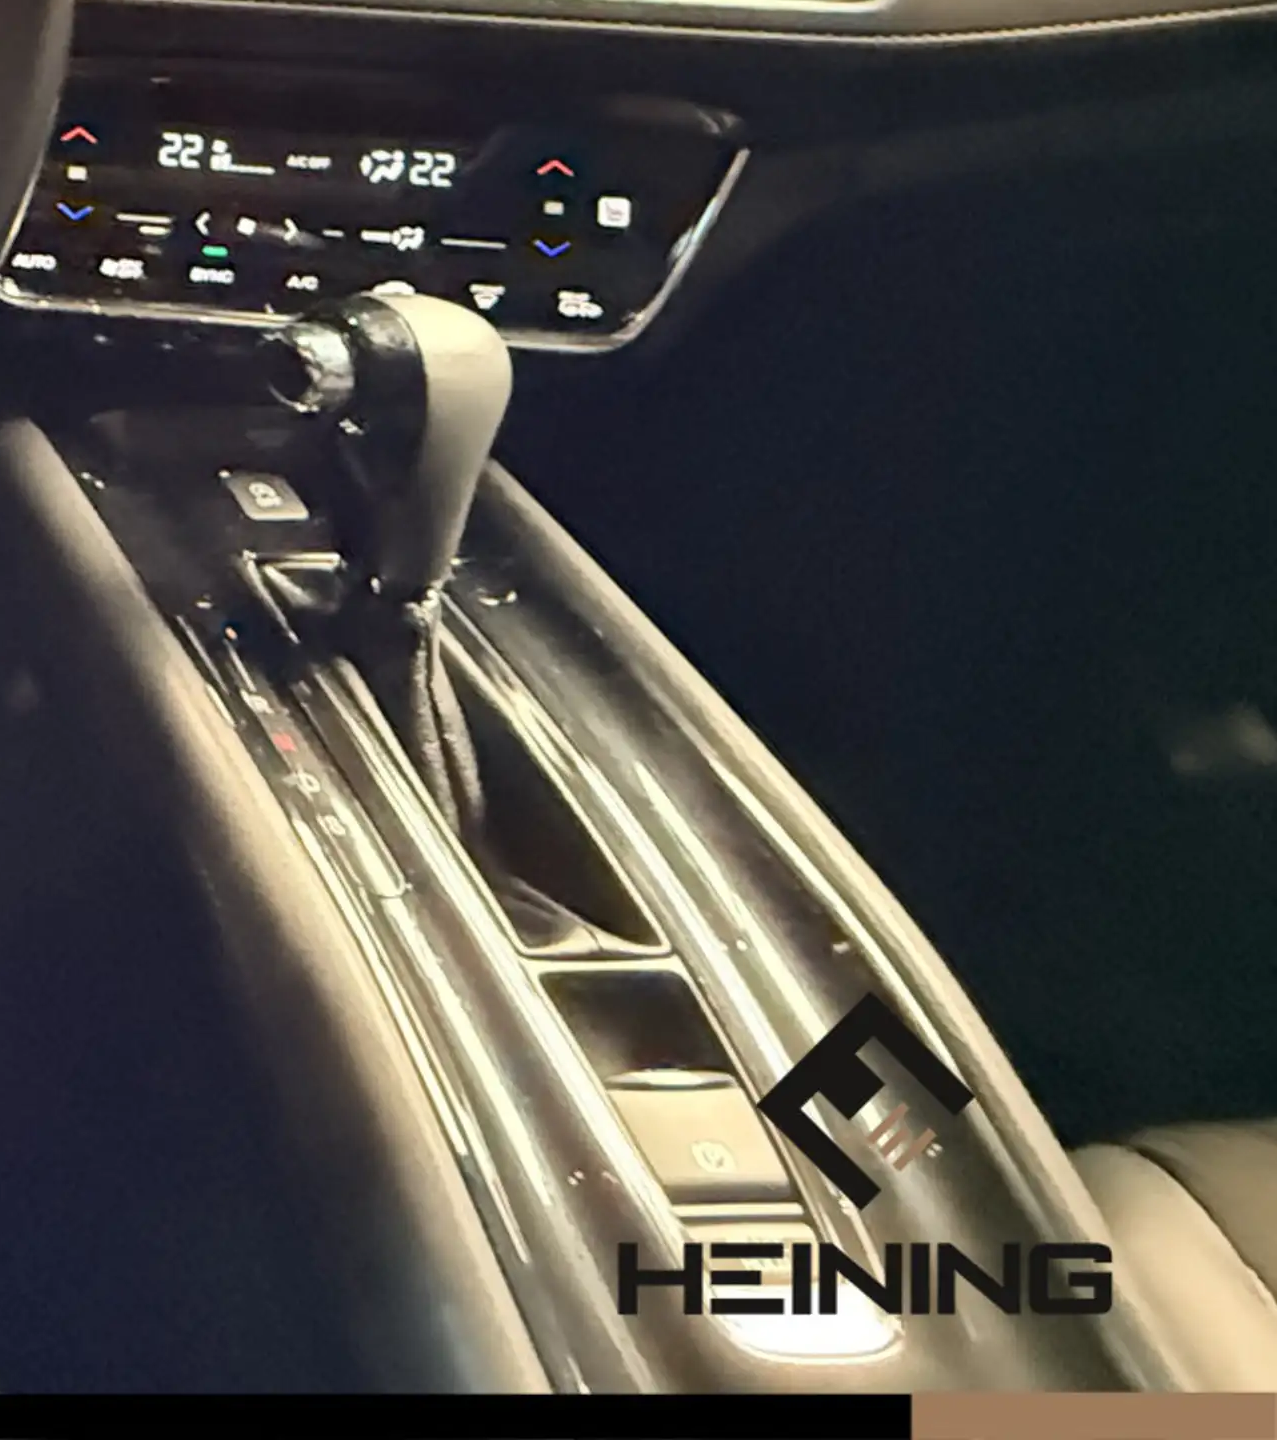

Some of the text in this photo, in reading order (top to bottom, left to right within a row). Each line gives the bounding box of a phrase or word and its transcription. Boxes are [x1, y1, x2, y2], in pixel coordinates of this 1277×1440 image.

[158, 131, 205, 169] 22
[408, 151, 456, 187] 22
[11, 253, 58, 271] AUTO
